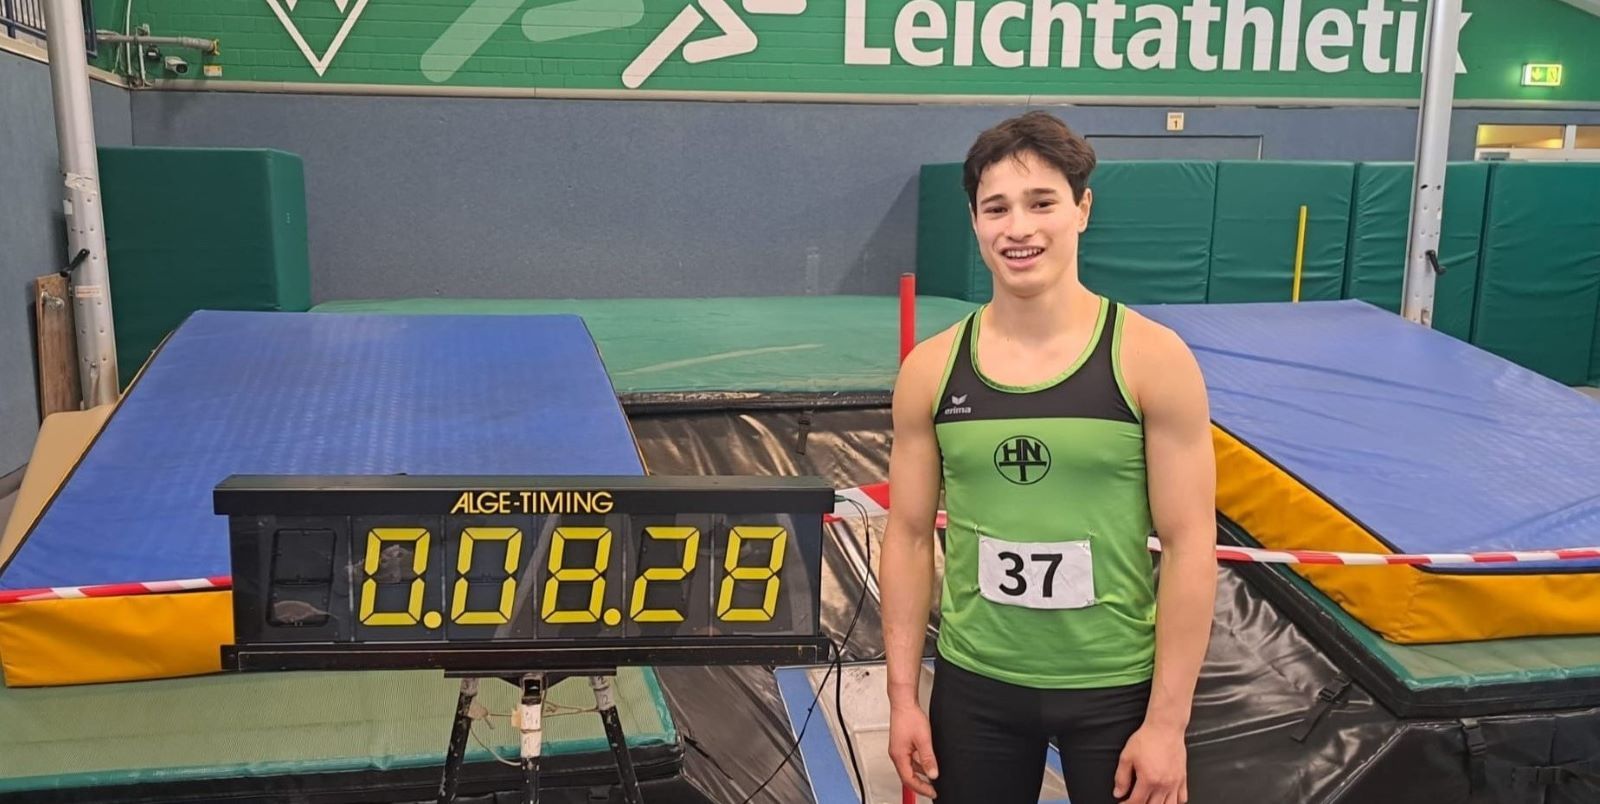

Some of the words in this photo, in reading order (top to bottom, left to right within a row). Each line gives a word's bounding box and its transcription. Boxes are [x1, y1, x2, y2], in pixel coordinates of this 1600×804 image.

[944, 406, 972, 415] erima
[450, 491, 614, 514] ALGE-TIMING
[359, 526, 788, 630] 0.08.28
[997, 551, 1063, 598] 37
